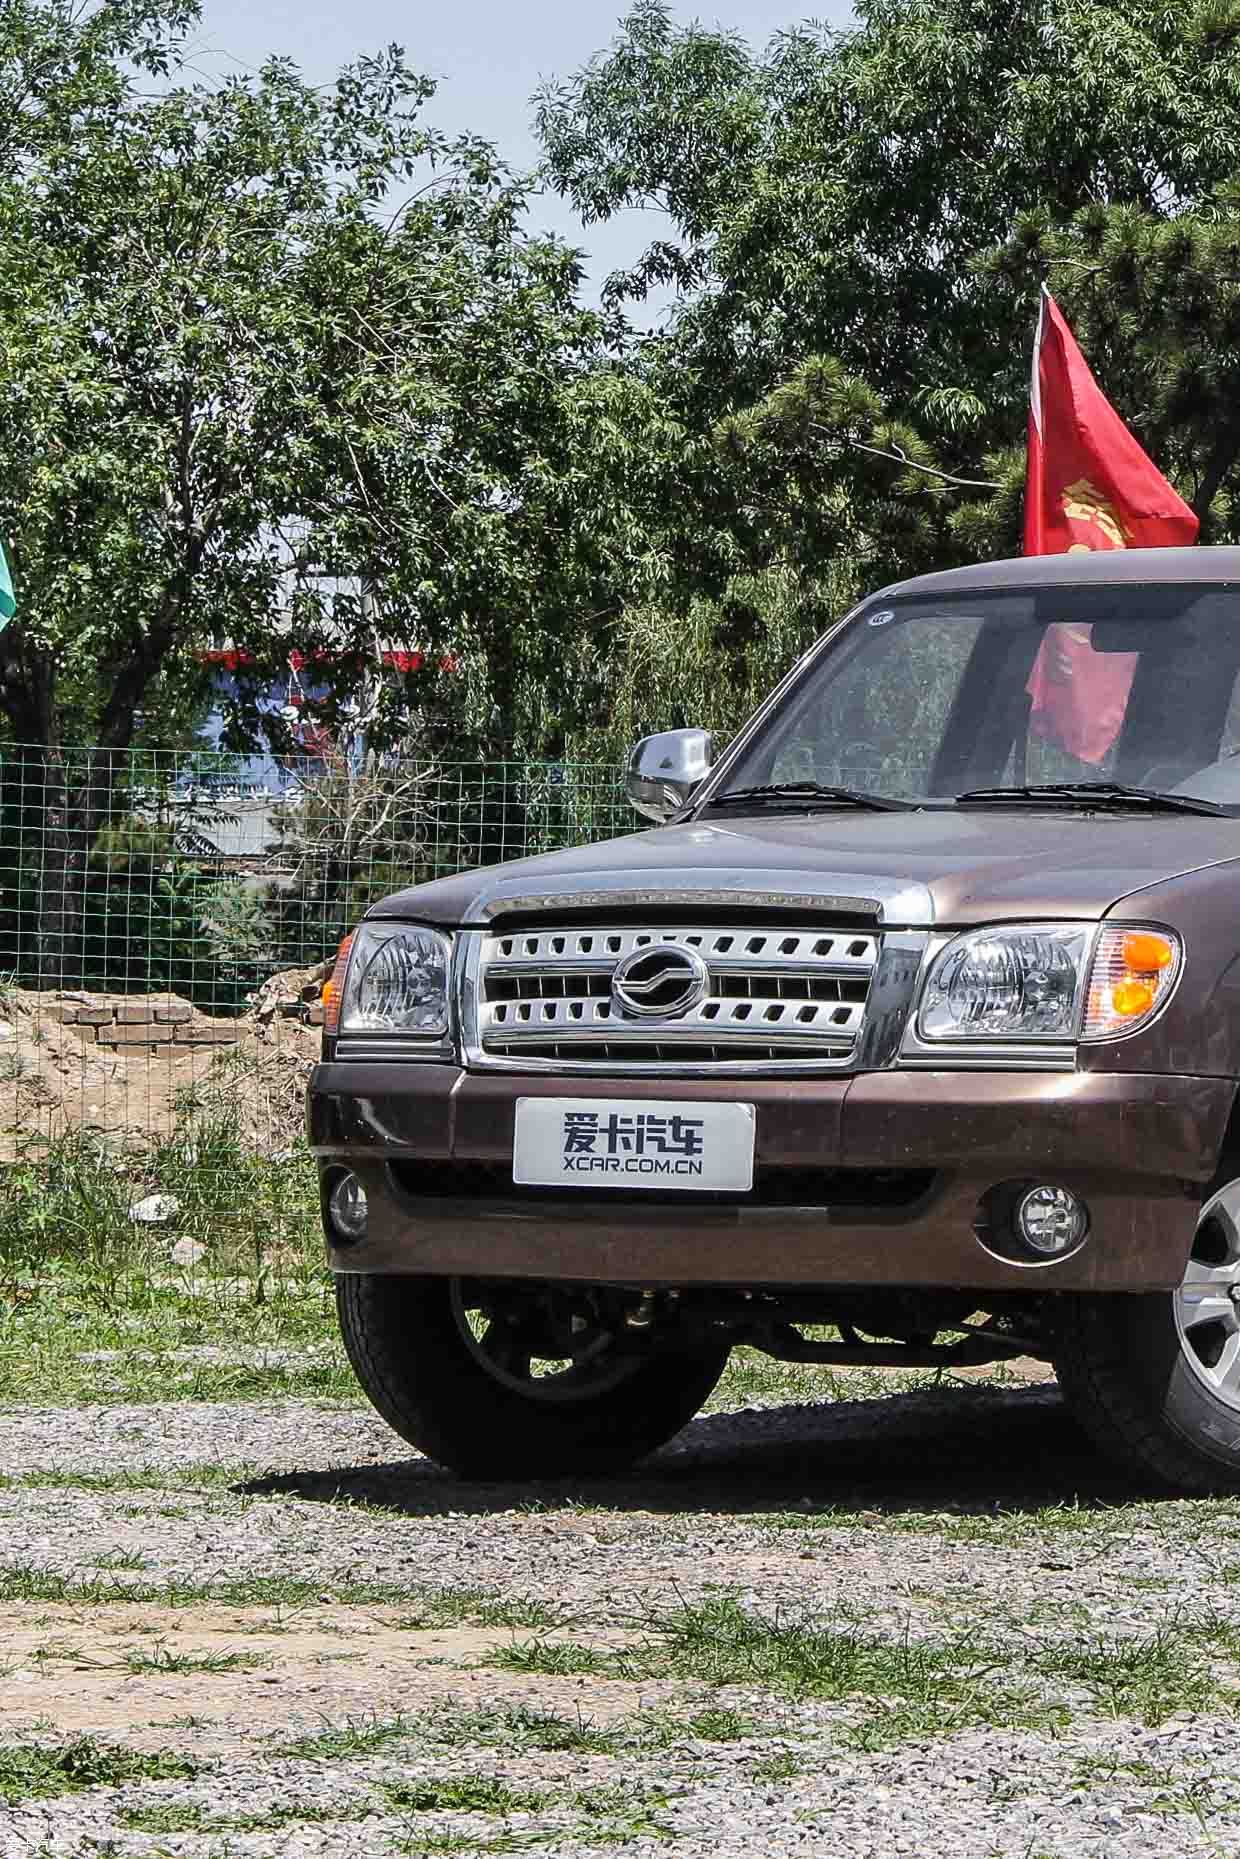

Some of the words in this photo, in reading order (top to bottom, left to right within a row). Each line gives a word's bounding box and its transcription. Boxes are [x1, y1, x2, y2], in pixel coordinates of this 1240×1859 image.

[563, 1113, 704, 1156] 爱卡汽车
[563, 1156, 702, 1175] XCAR.COM.CN
